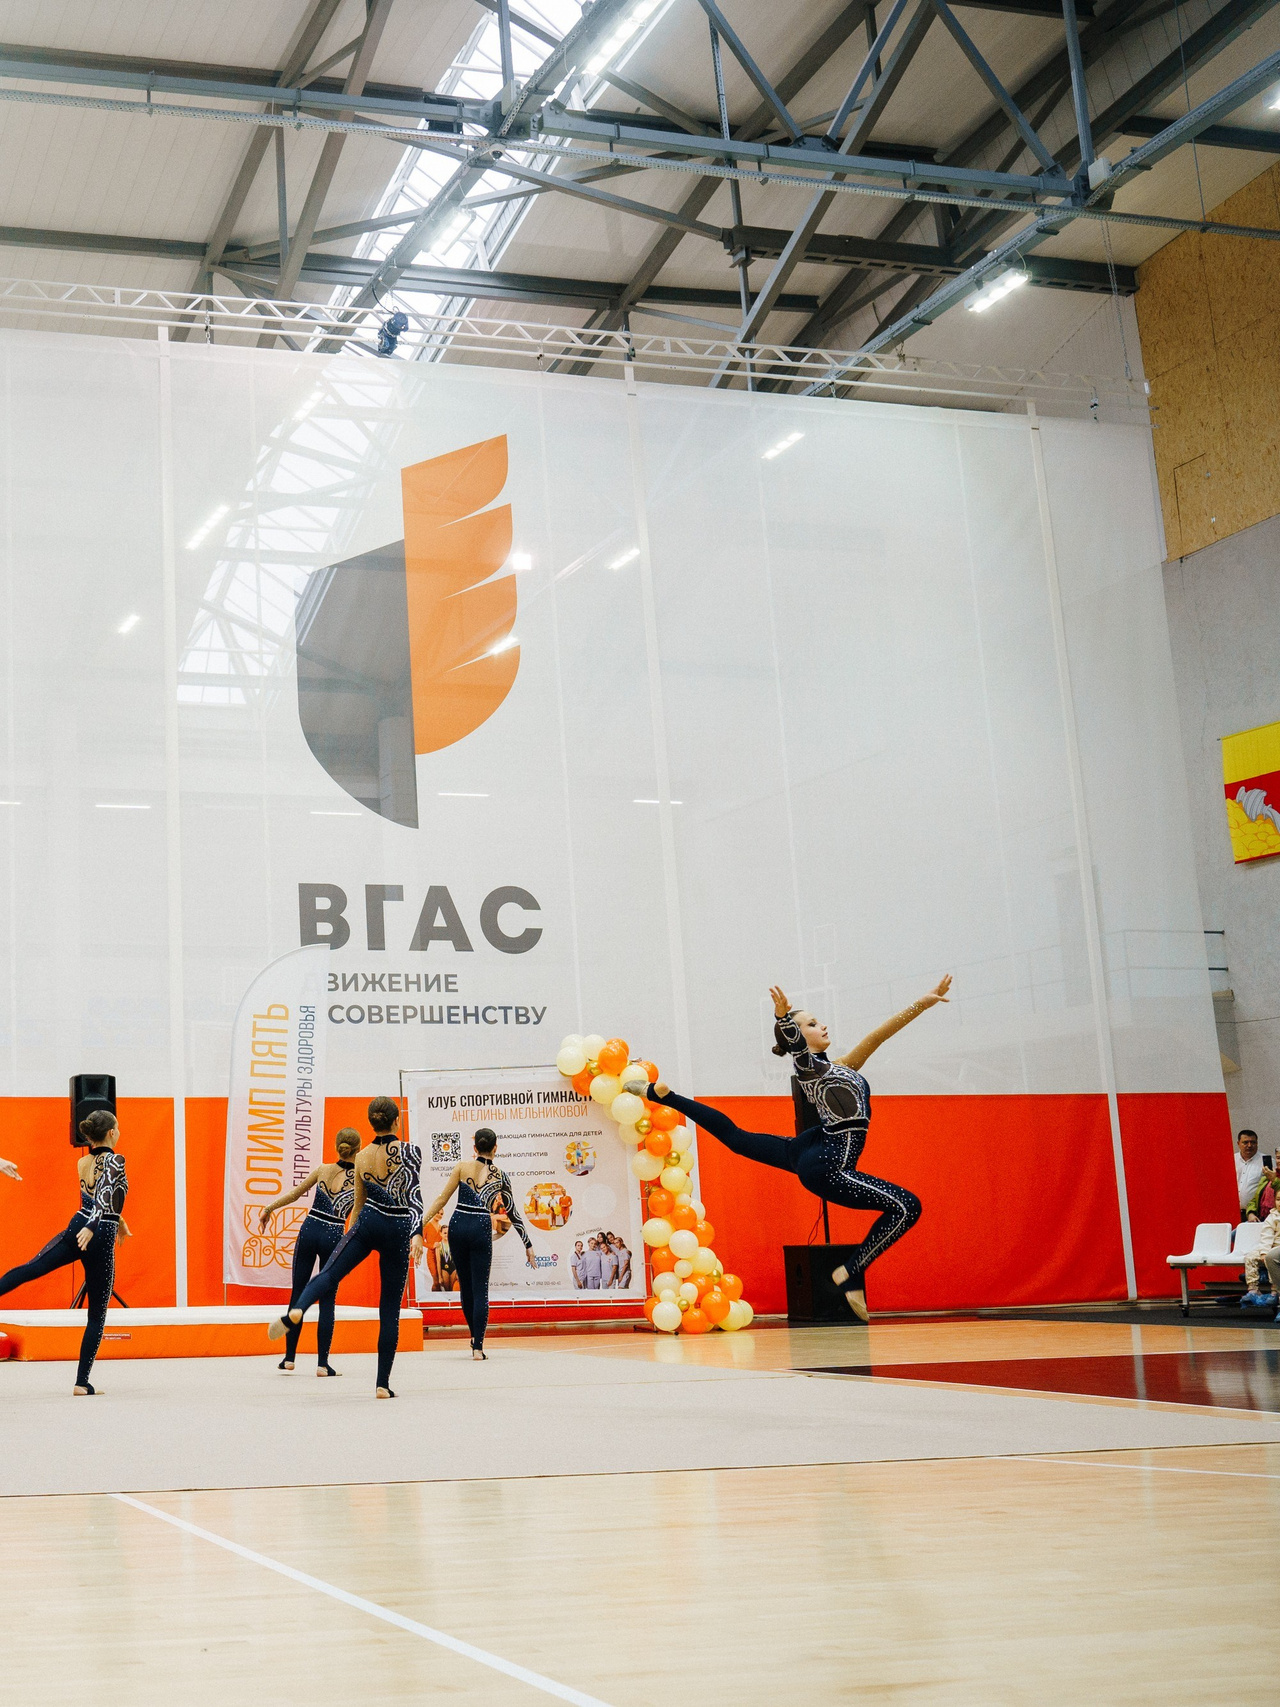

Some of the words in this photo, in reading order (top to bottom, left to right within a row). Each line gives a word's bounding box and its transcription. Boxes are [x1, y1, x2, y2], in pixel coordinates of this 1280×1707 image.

[298, 882, 544, 955] ВГАС
[327, 972, 459, 993] ВИЖЕНИЕ
[327, 1004, 548, 1026] СОВЕРШЕНСТВУ
[250, 1003, 290, 1079] ПЯТЬ
[296, 1005, 316, 1075] ЗДОРОВЬЯ
[294, 1078, 313, 1151] КУЛЬТУРЫ
[427, 1095, 457, 1110] КЛУБ
[460, 1089, 534, 1107] СПОРТИВНОЙ
[452, 1109, 508, 1122] АНГЕЛИНЫ
[509, 1104, 588, 1121] МЕЛЬНИКОВОЙ
[245, 1088, 286, 1196] ОЛИМП
